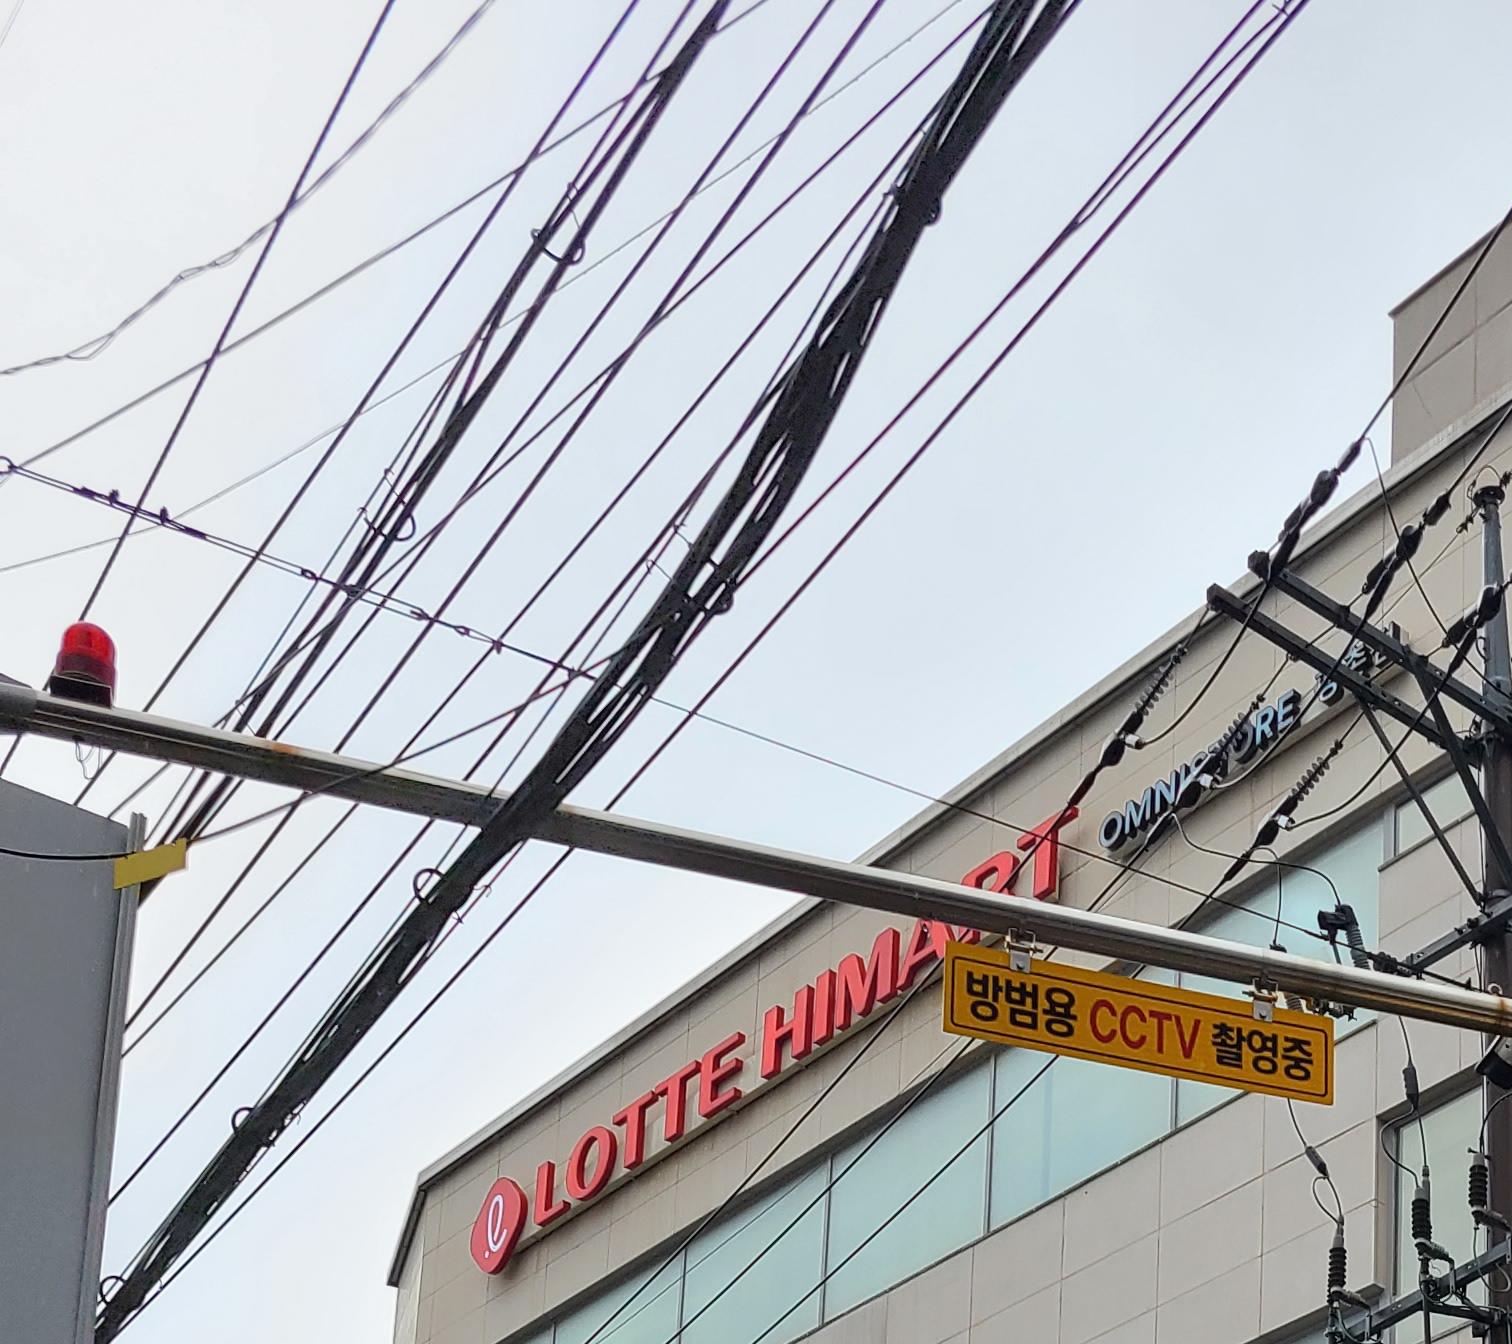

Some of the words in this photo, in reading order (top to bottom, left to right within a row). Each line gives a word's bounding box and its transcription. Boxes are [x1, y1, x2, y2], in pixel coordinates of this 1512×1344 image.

[534, 1032, 745, 1227] LOTTE
[762, 805, 1079, 1080] HIMART
[965, 970, 1078, 1038] 방범용
[1089, 999, 1202, 1059] CCTV
[1211, 1022, 1314, 1082] 촬영중
